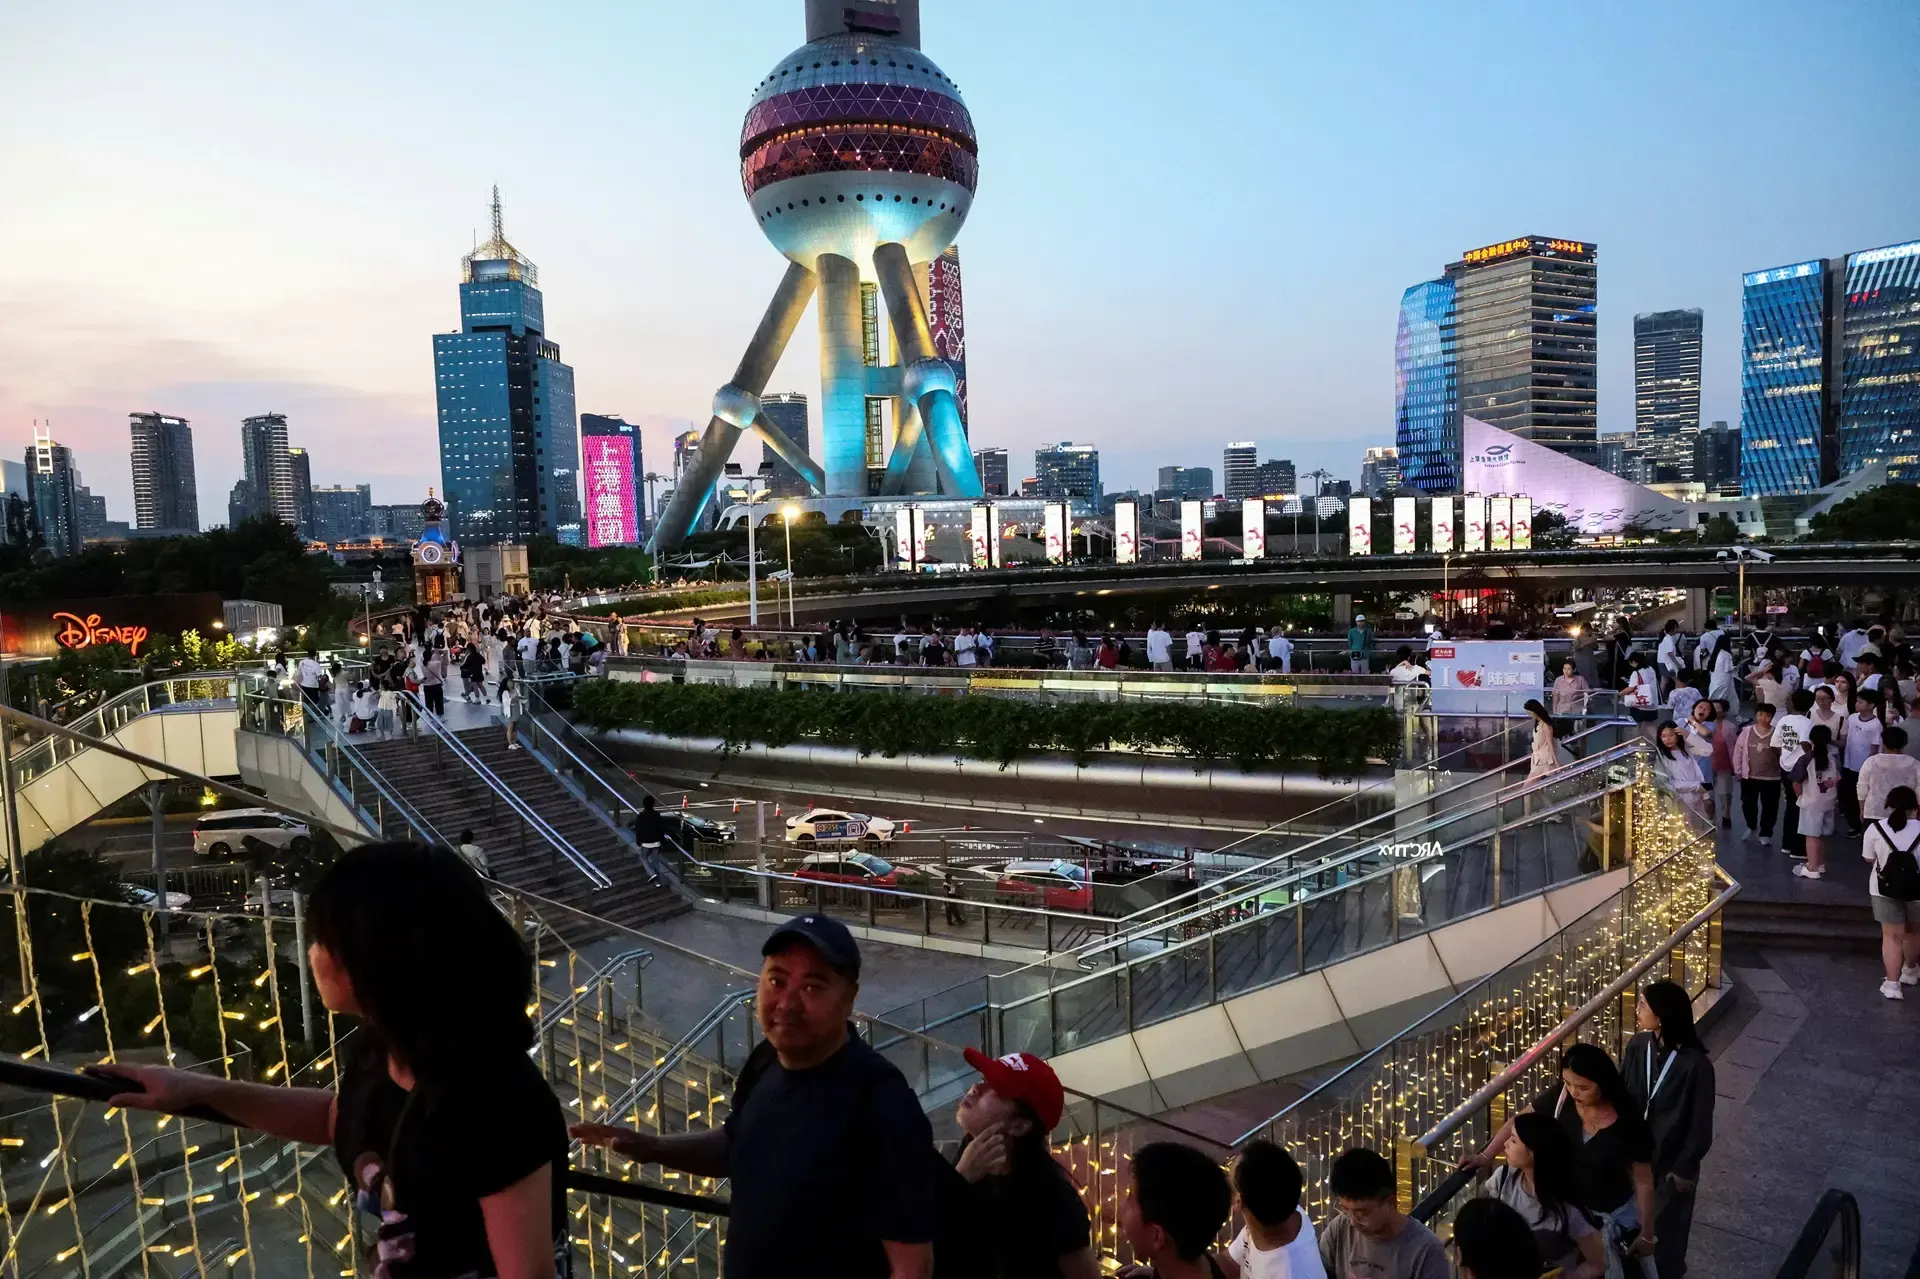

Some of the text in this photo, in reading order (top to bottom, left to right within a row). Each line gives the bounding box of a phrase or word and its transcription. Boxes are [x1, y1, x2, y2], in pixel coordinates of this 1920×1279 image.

[1465, 239, 1529, 262] 中国金融信息中心
[1487, 671, 1536, 686] 陆家嘴
